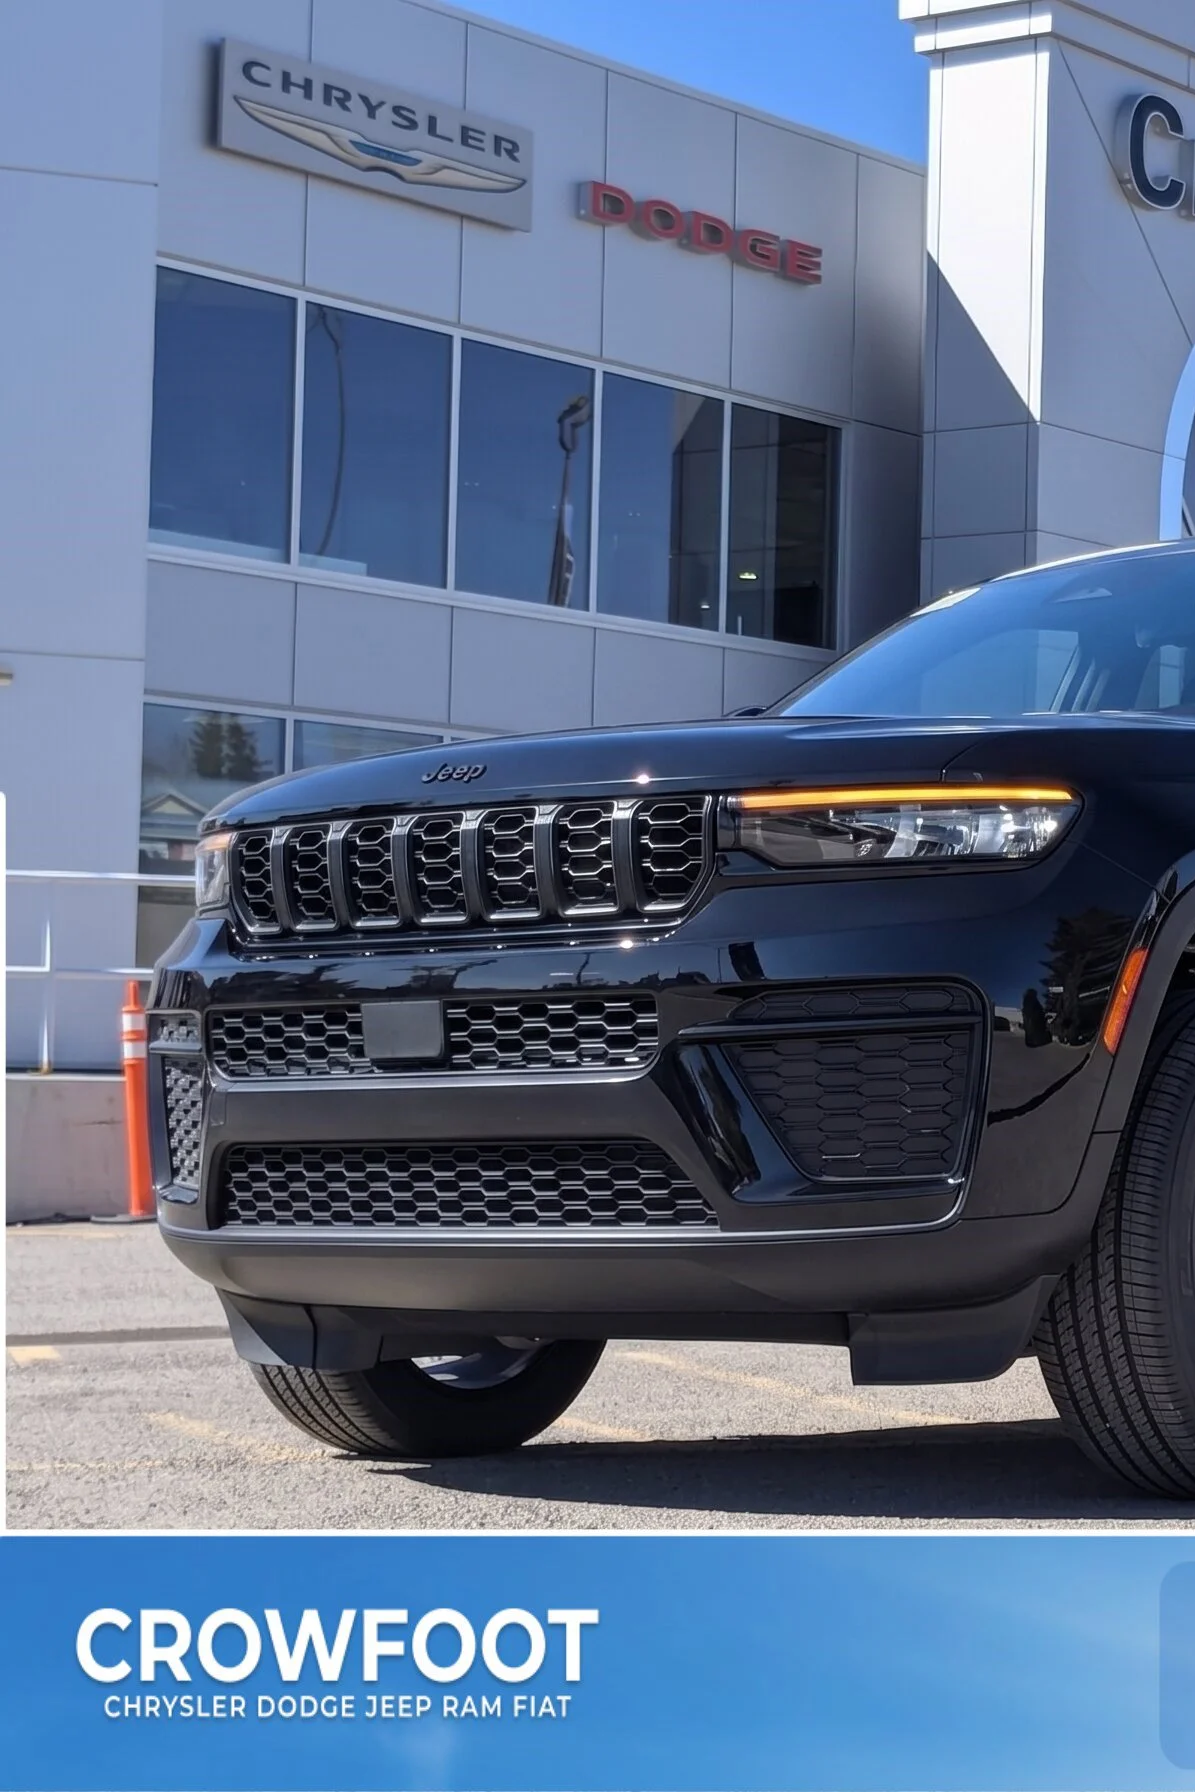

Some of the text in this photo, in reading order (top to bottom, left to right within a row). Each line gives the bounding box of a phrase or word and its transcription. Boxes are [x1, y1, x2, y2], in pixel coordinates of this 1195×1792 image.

[240, 59, 521, 164] CHRYSLER
[587, 180, 824, 286] DODGE
[421, 763, 487, 784] Jeep
